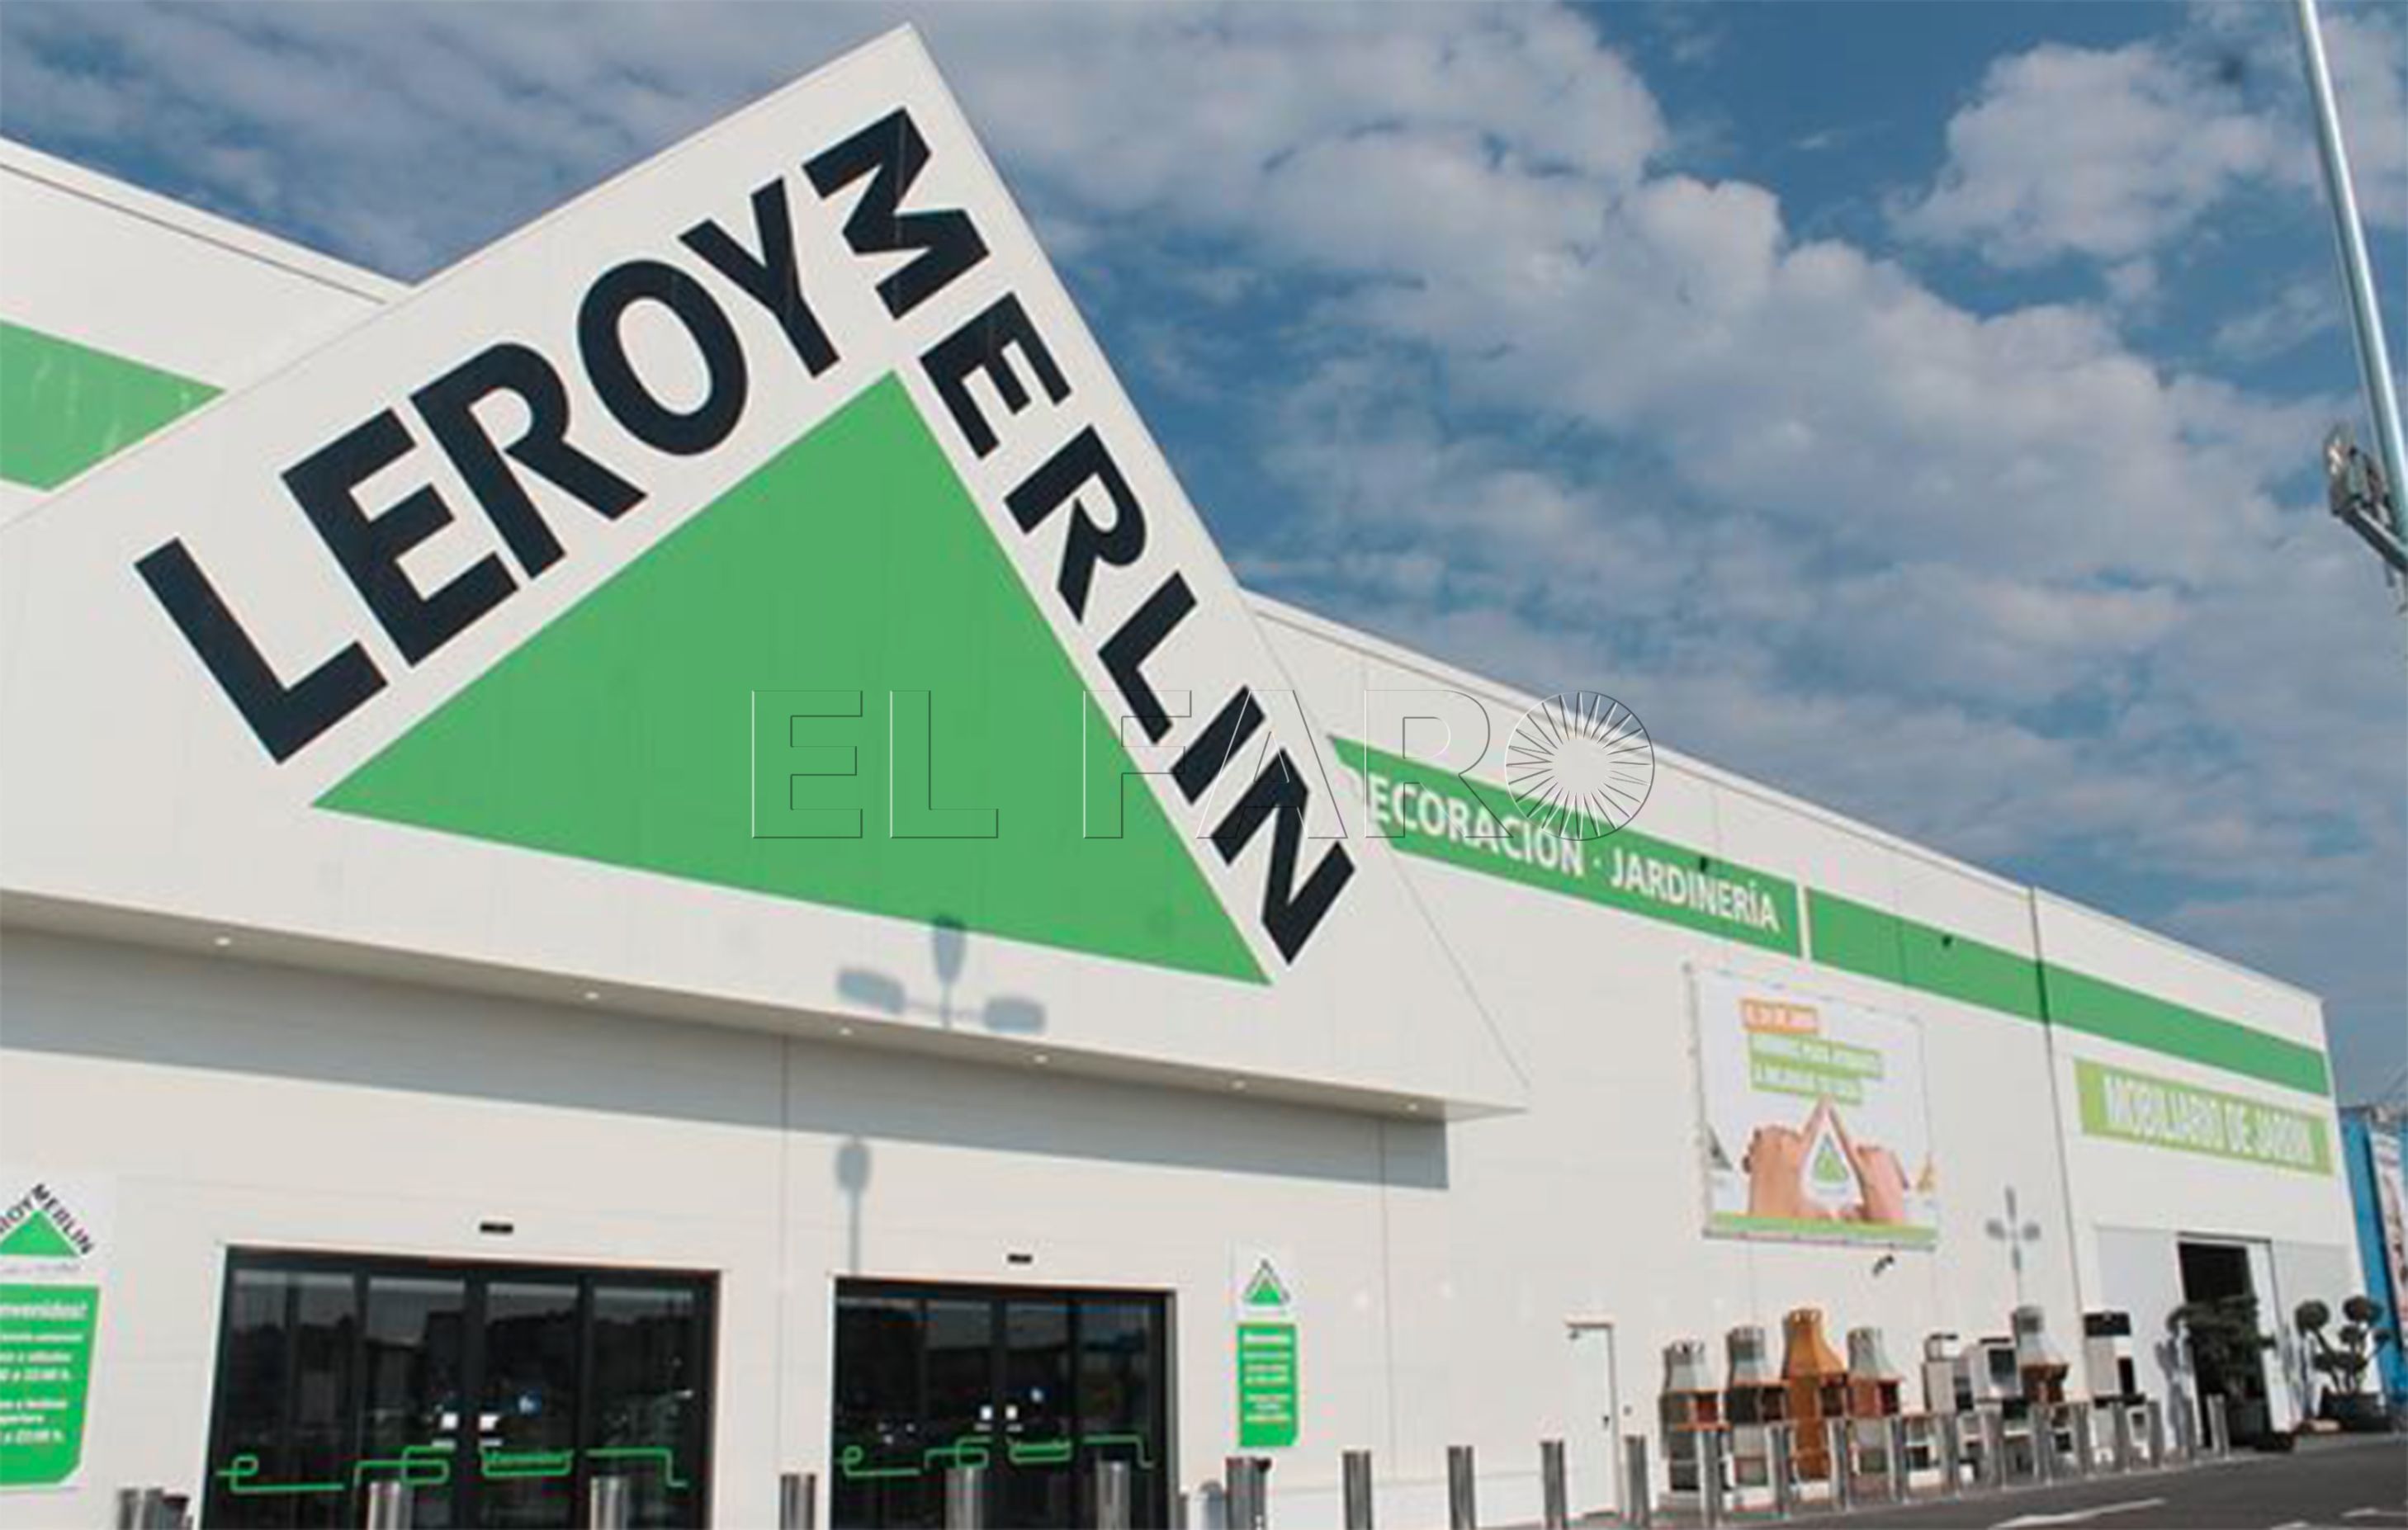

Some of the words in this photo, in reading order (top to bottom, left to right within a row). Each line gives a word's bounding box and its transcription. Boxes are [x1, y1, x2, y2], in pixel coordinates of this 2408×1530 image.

[134, 177, 840, 764] LEROY
[802, 106, 1356, 966] MERLIN
[1611, 848, 1781, 933] JARDINERÍA
[32, 1183, 96, 1255] MERLIN
